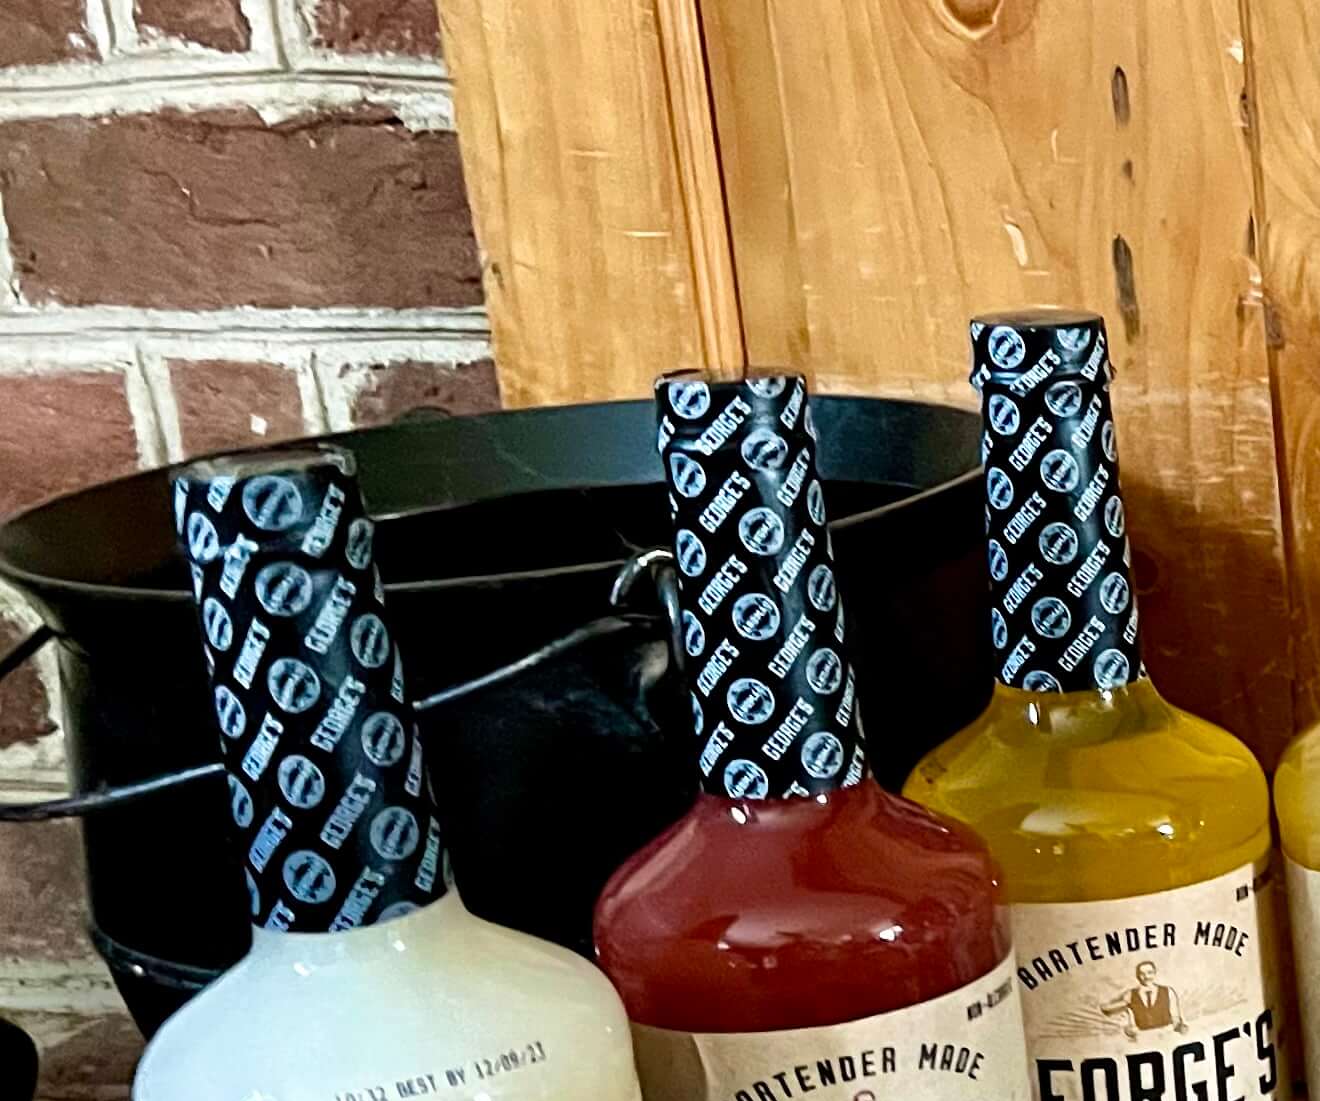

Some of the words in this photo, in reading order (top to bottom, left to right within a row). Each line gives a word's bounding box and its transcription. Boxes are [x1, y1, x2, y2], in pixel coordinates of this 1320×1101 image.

[1008, 415, 1054, 473] GEORGE'S
[1067, 539, 1112, 599] GEORGE'S
[761, 695, 816, 762] GEORGE'S
[320, 773, 378, 850] GEORGE'S
[1017, 923, 1177, 990] BARTENDER
[1194, 921, 1250, 958] MADE
[396, 1074, 437, 1098] BEST
[446, 1068, 465, 1086] BY
[919, 1043, 986, 1081] MADE
